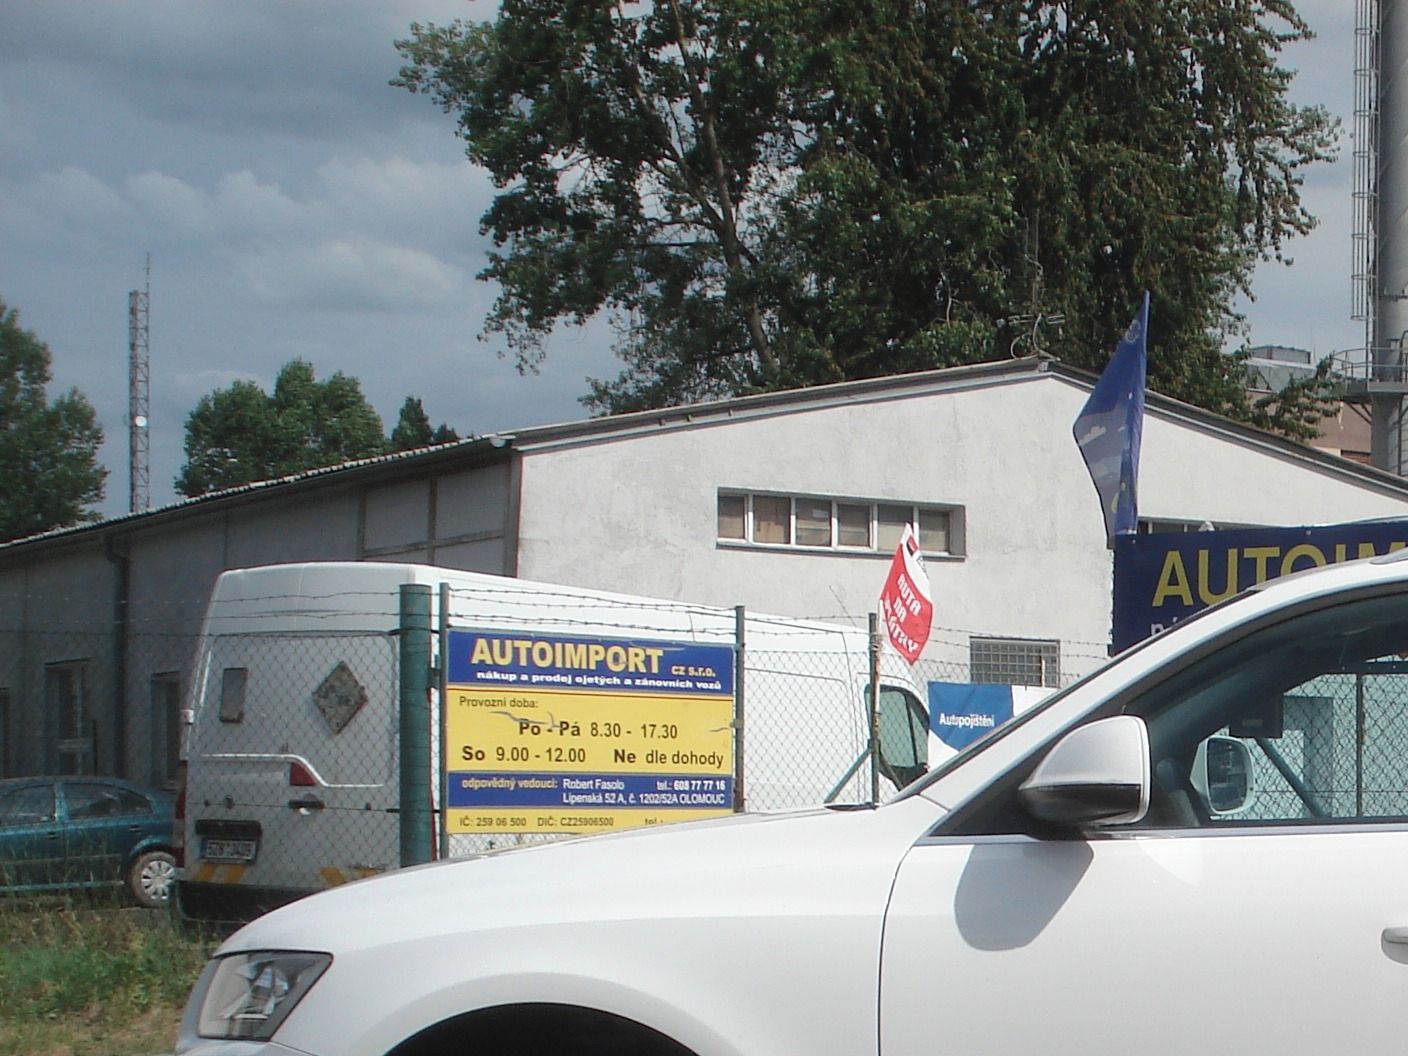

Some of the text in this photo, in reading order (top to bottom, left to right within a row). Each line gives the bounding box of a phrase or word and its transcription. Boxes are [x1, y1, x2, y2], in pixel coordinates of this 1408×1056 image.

[471, 638, 664, 674] AUTOIMPORT
[688, 666, 716, 678] s.r.o.
[476, 671, 517, 682] nákup
[532, 673, 572, 685] prodej
[575, 675, 620, 686] ojetých
[624, 678, 633, 686] a
[635, 677, 693, 689] zánovních
[696, 680, 722, 690] vozů
[509, 698, 538, 709] doba:
[519, 719, 541, 735] Po
[559, 720, 581, 736] Pá
[590, 722, 621, 738] 8.30
[640, 723, 678, 739] 17.30
[462, 745, 486, 761] So
[496, 746, 529, 761] 9.00
[546, 747, 586, 763] 12.00
[613, 749, 636, 764] Ne
[645, 749, 668, 764] dle
[671, 750, 724, 769] dohody
[562, 778, 594, 790] Robert
[690, 780, 702, 791] 77
[703, 781, 714, 791] 77
[679, 794, 726, 804] OLOMOUC
